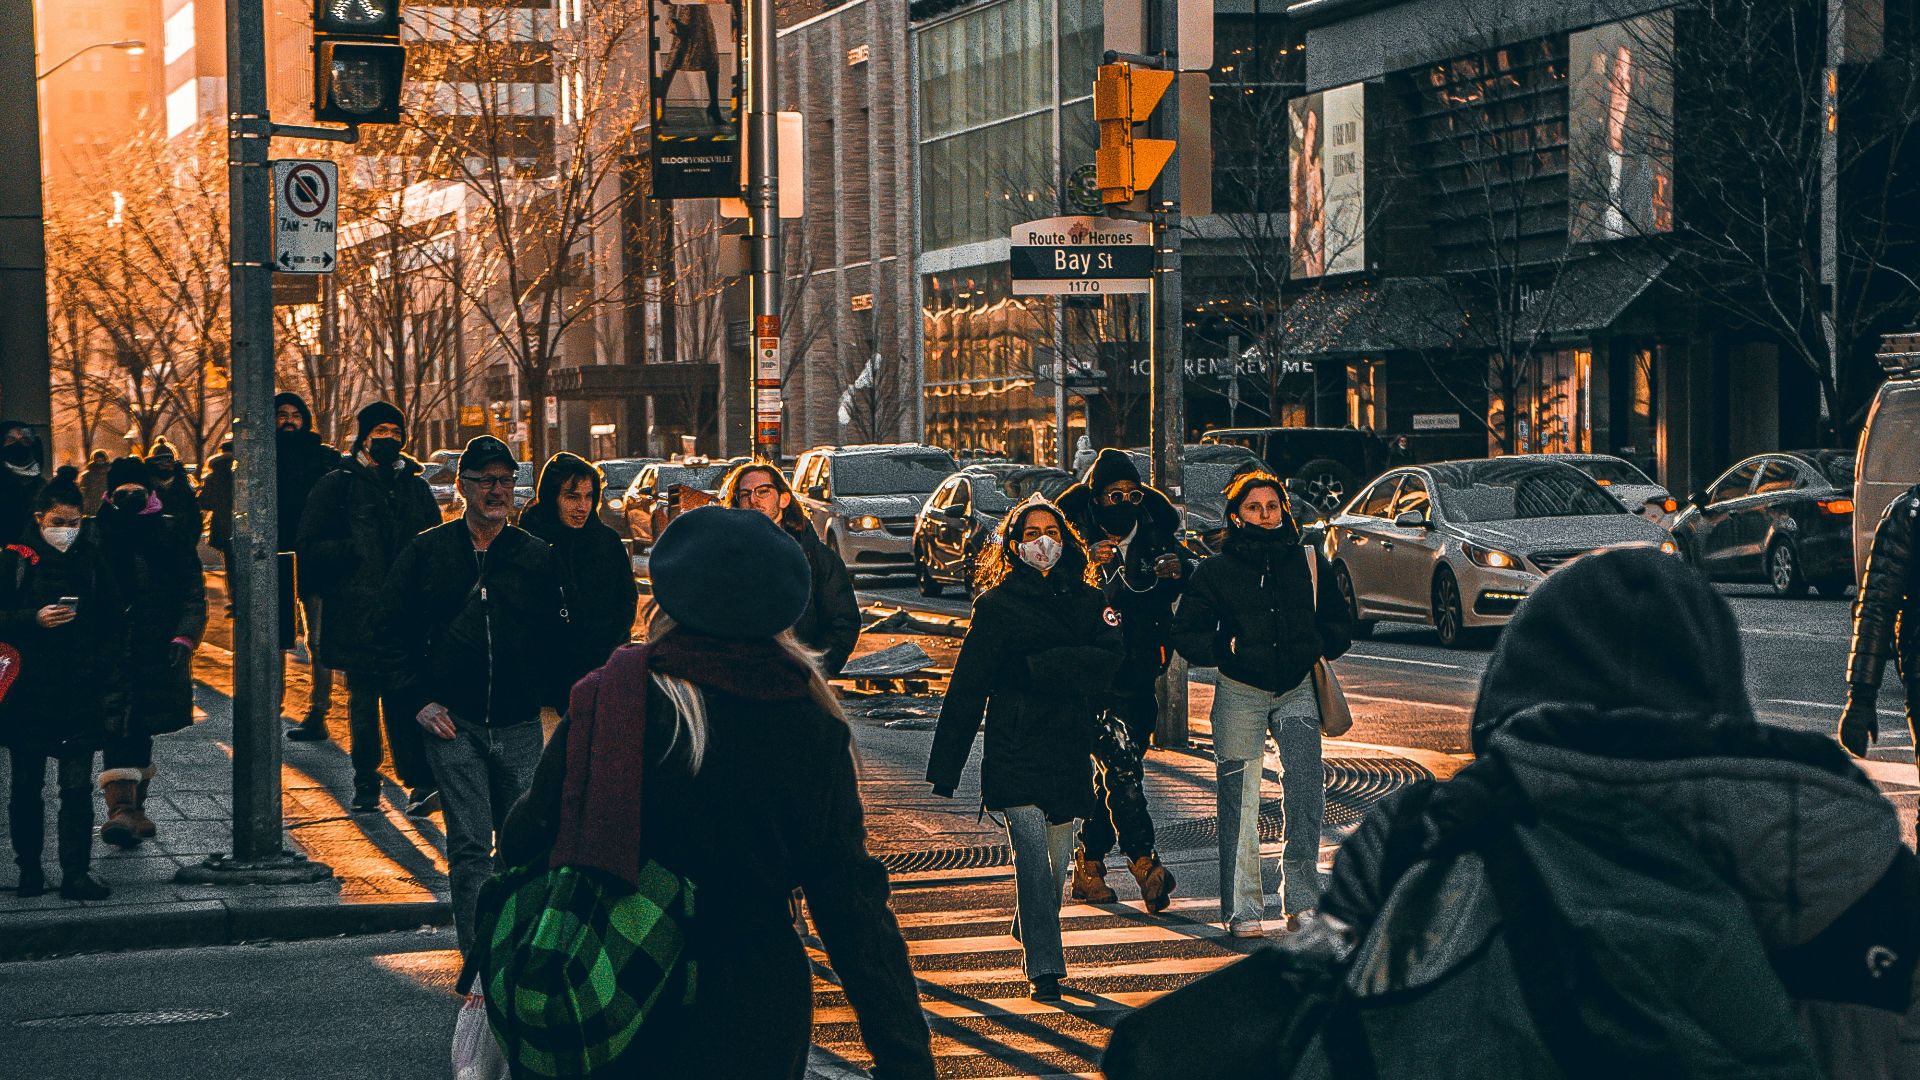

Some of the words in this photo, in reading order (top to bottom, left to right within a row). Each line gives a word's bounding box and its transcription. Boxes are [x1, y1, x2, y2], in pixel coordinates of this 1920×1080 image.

[280, 217, 300, 232] 7AM
[313, 218, 334, 232] 7PM
[1029, 231, 1066, 246] Route
[1071, 231, 1084, 245] of
[1088, 231, 1133, 245] Heroes
[1055, 249, 1091, 275] Bay
[1098, 252, 1113, 269] St
[1069, 281, 1100, 292] 1170
